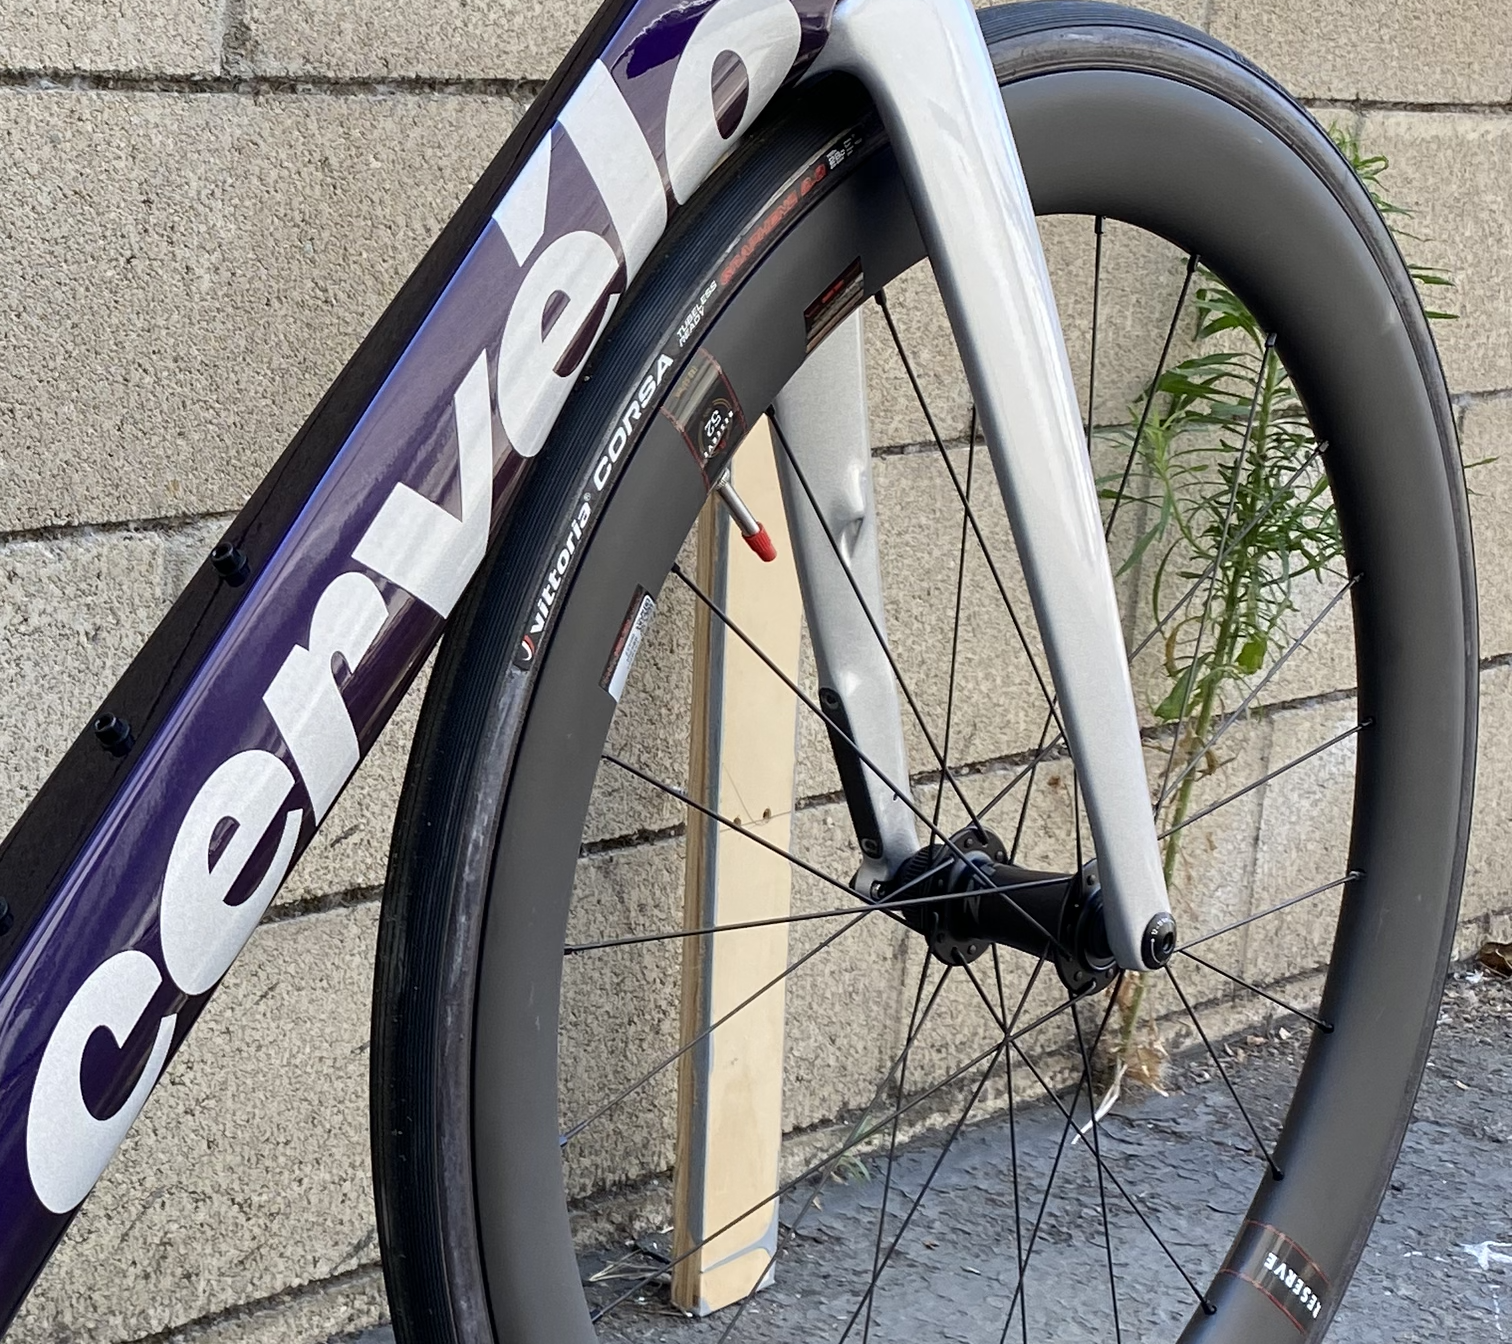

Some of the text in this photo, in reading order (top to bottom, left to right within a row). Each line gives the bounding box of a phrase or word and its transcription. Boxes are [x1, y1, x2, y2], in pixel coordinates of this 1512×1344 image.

[679, 304, 705, 348] READY
[593, 353, 674, 491] CORSA
[704, 409, 722, 438] 52
